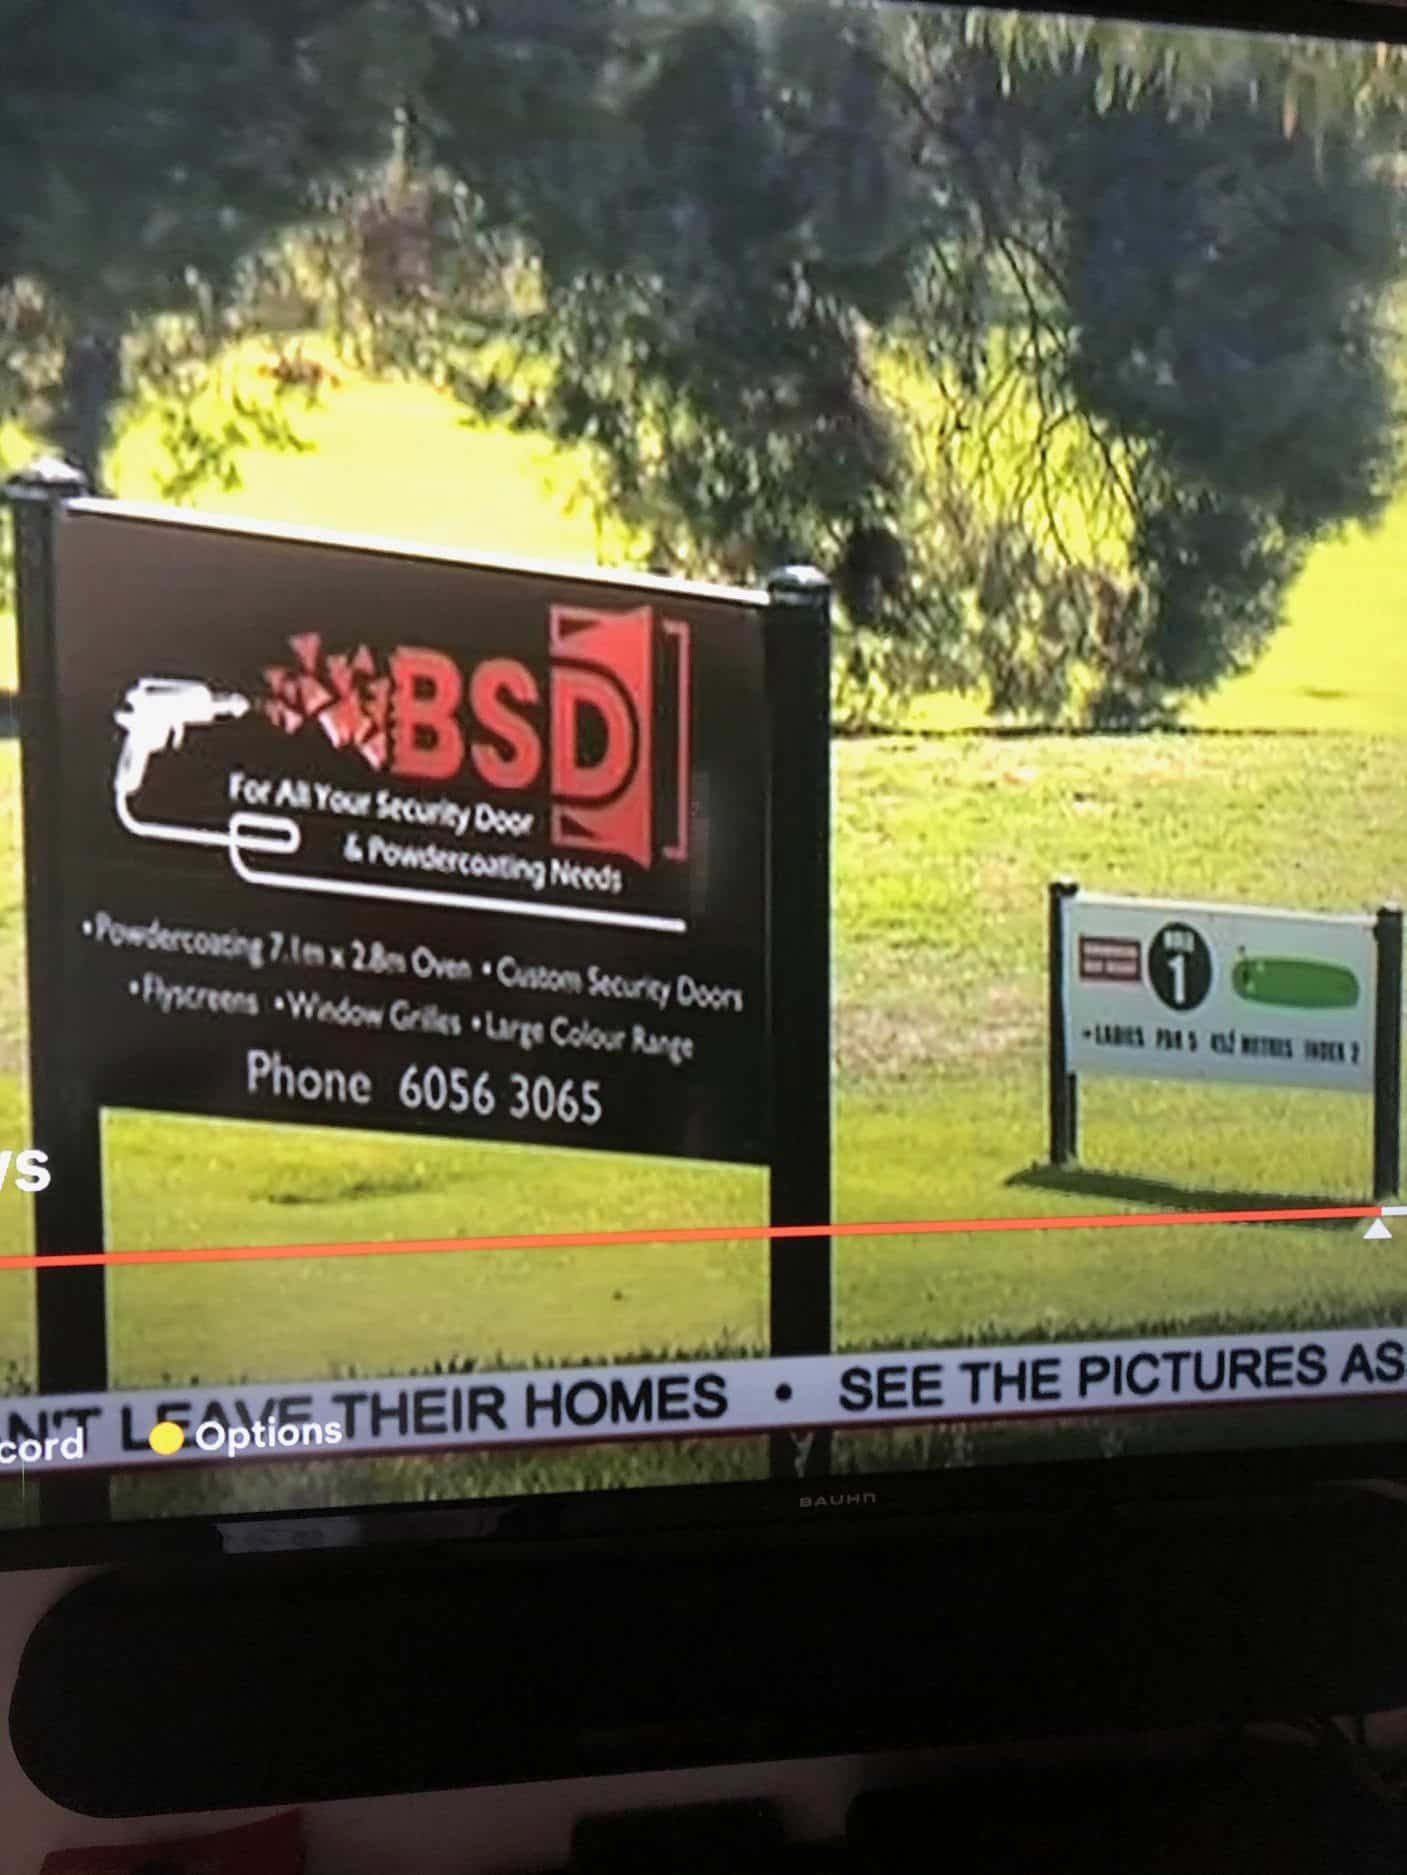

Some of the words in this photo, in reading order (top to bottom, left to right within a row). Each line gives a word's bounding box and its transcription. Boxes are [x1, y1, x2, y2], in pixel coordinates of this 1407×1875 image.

[389, 643, 650, 800] BSD
[228, 771, 273, 804] For
[275, 778, 311, 808] All
[312, 785, 371, 816] Your
[376, 789, 470, 836] Security
[474, 803, 535, 836] Door
[343, 832, 365, 862] &
[369, 835, 546, 890] Powdercoating
[550, 860, 624, 894] Needs
[95, 910, 265, 969] Powdercoating
[411, 946, 472, 981] Oven
[496, 955, 583, 995] Custom
[588, 965, 671, 1012] Security
[676, 974, 744, 1013] Doors
[1167, 953, 1186, 1005] 1
[286, 990, 384, 1030] Window
[484, 1011, 545, 1051] Large
[550, 1016, 626, 1051] Colour
[632, 1024, 694, 1066] Range
[246, 1048, 372, 1104] Phone
[399, 1063, 496, 1116] 6056
[508, 1073, 604, 1125] 3065
[0, 1407, 101, 1454] N'T
[120, 1395, 313, 1451] LEAVE
[331, 1383, 506, 1440] THEIR
[524, 1371, 728, 1430] HOMES
[838, 1363, 943, 1412] SEE
[959, 1357, 1061, 1403] THE
[1079, 1343, 1327, 1396] PICTURES
[1340, 1340, 1405, 1384] AS
[195, 1416, 343, 1458] Options
